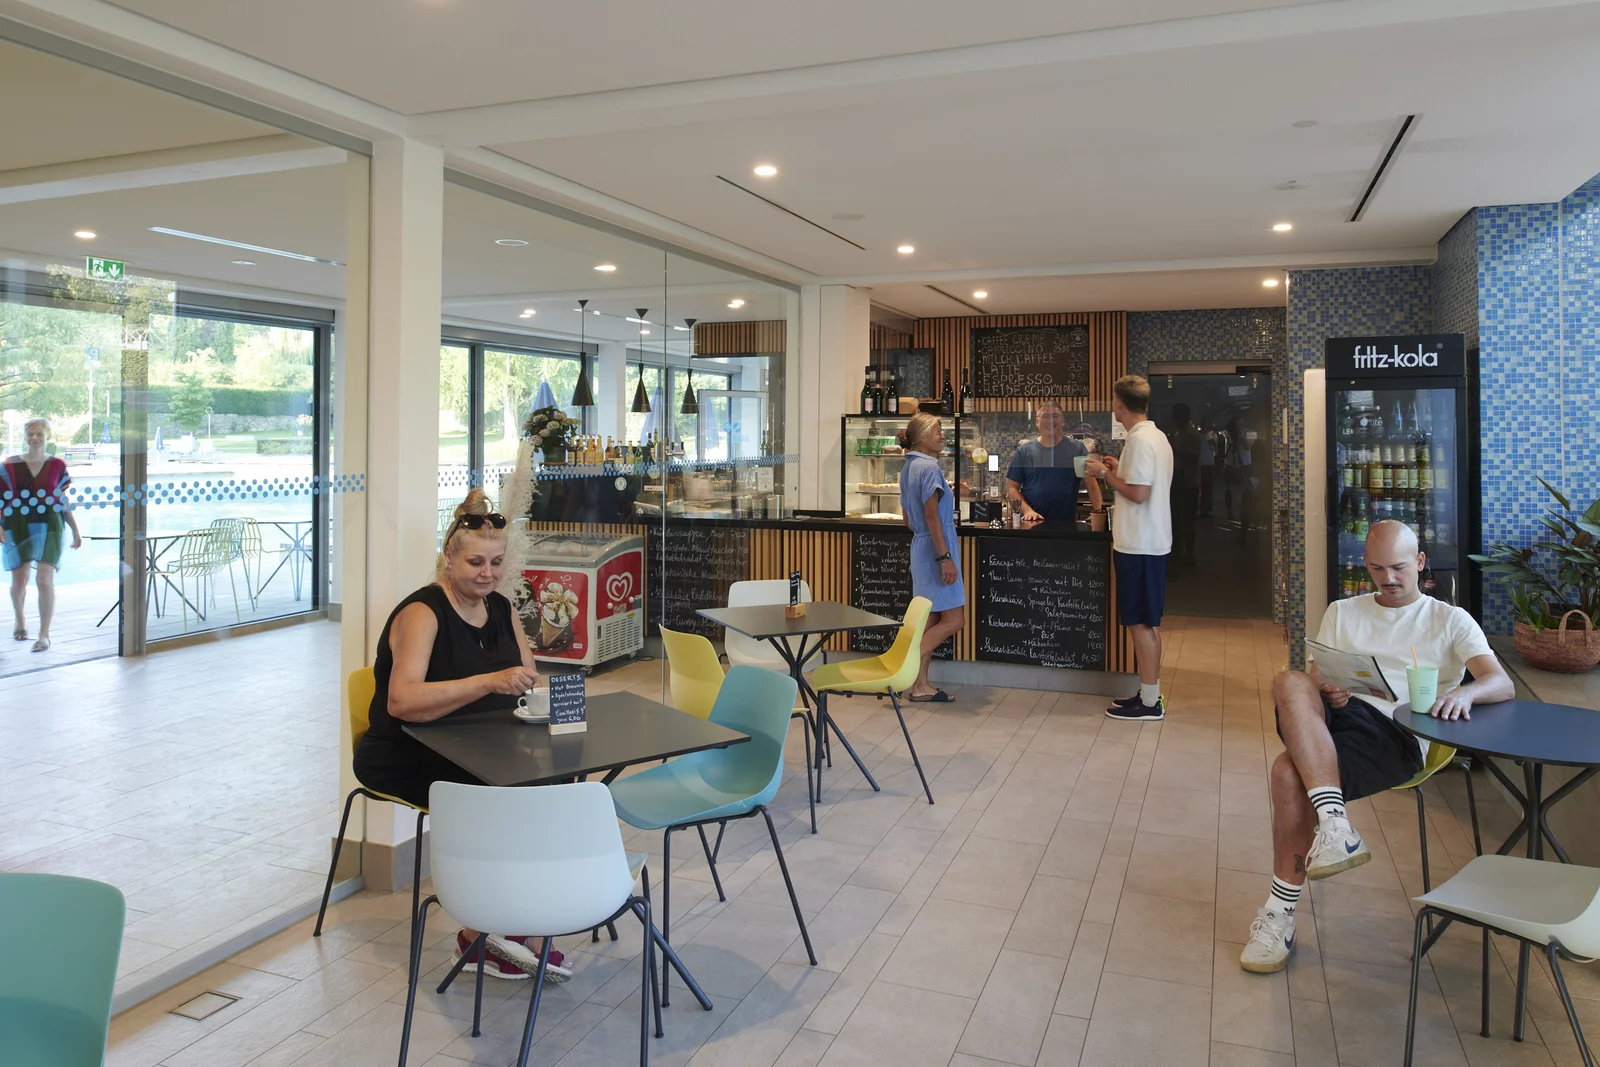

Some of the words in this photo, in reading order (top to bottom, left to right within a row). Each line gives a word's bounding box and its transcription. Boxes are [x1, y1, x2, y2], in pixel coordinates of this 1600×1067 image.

[981, 335, 1009, 346] KAFFEE
[1012, 334, 1045, 346] CREME
[981, 344, 1044, 354] CAPPUCCINO
[1353, 344, 1438, 368] fritz-kola
[982, 364, 1020, 376] LATTE
[984, 374, 1052, 385] ESPRESSO
[1054, 576, 1068, 587] mit
[1040, 630, 1055, 640] Reis
[551, 674, 582, 682] DESERTS
